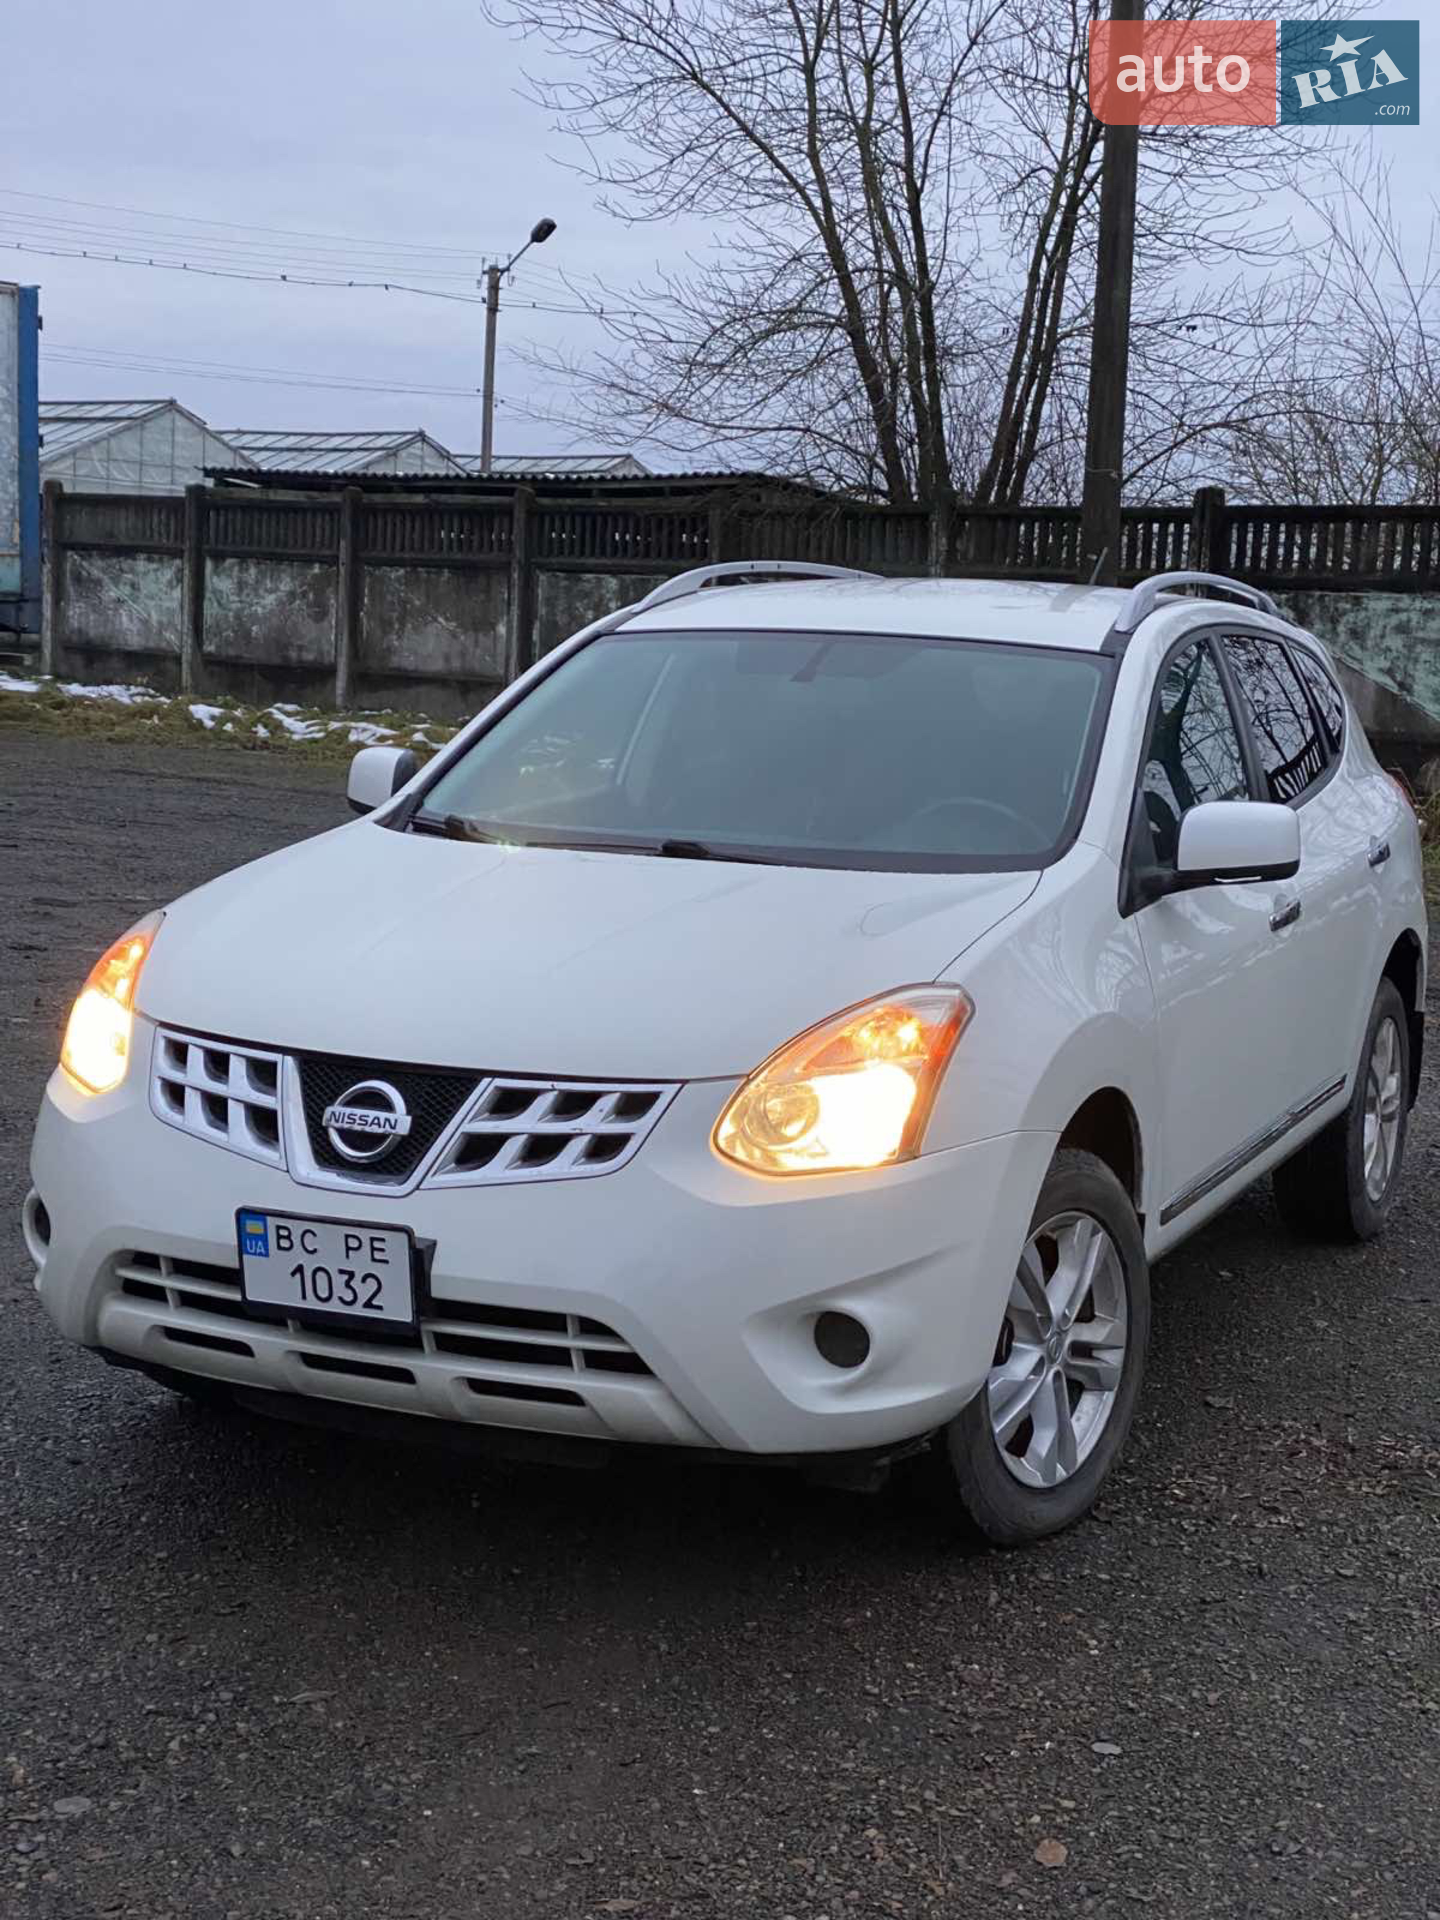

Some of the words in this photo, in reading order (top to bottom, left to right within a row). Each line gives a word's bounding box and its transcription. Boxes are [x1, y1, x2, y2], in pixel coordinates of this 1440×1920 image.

[329, 1111, 398, 1130] NISSAN
[246, 1239, 266, 1255] UA
[275, 1224, 318, 1255] BC
[344, 1233, 390, 1264] PE
[290, 1263, 384, 1311] 1032
